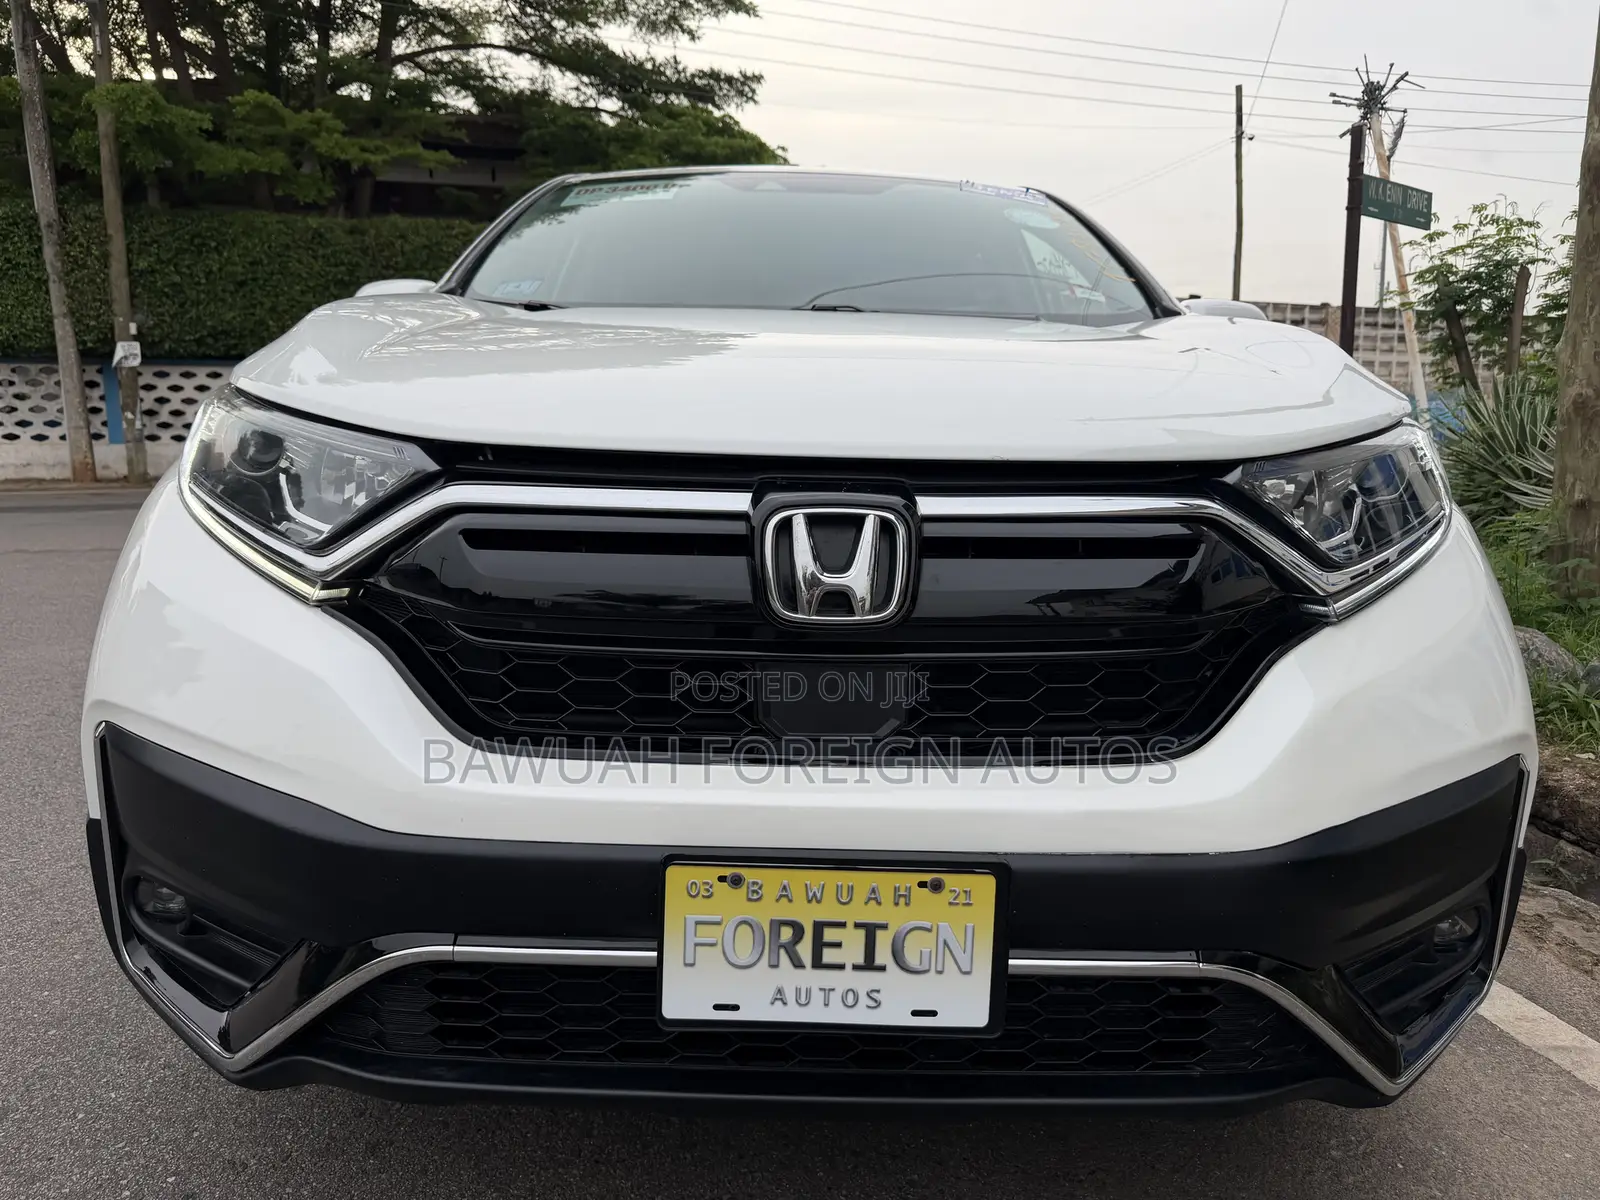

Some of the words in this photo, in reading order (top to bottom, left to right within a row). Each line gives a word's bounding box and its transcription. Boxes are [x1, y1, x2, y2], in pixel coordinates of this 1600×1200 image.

[1406, 188, 1429, 212] DRIVE
[686, 879, 714, 898] 03
[747, 879, 912, 906] BAWUAH
[948, 887, 974, 906] 21
[683, 914, 976, 975] FOREIGN
[770, 985, 882, 1010] AUTOS
